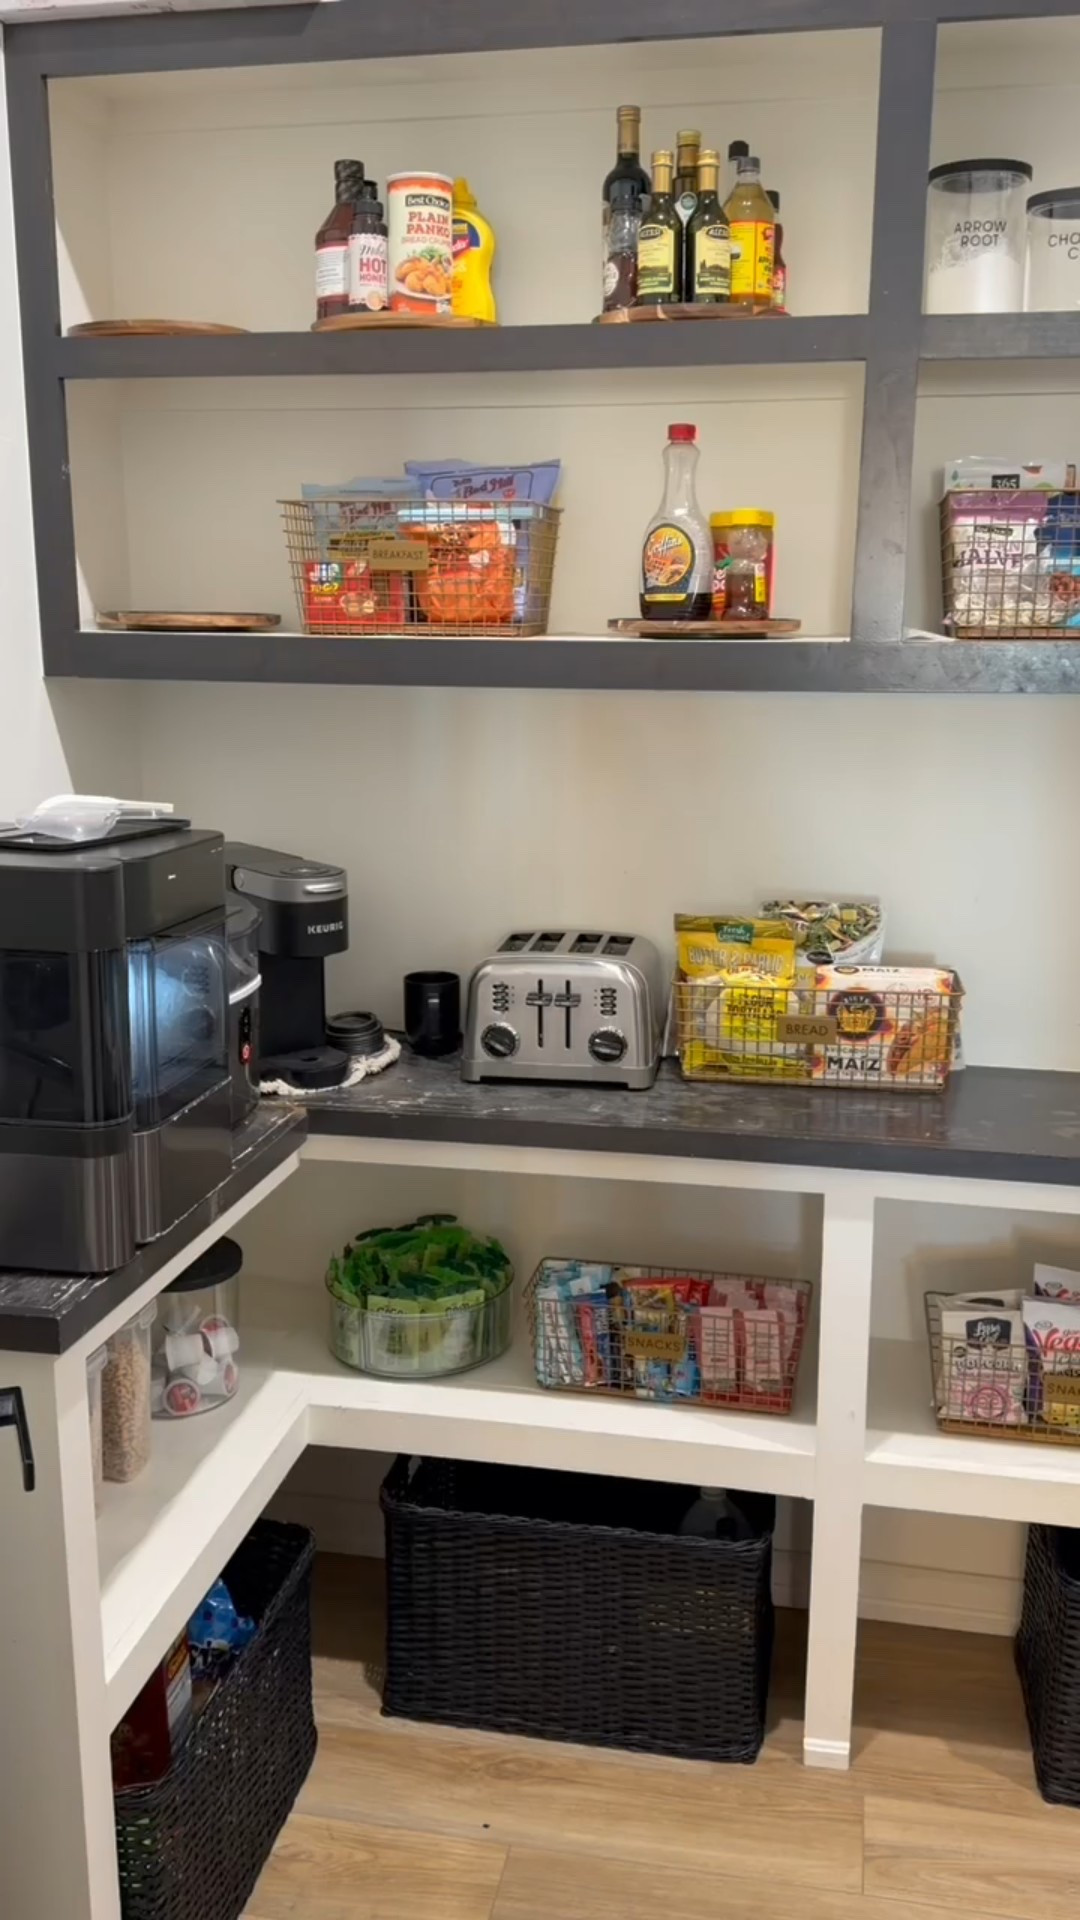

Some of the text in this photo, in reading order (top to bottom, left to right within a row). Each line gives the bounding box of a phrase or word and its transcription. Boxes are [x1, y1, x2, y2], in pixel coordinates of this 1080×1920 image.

[408, 211, 448, 225] PLAIN
[406, 224, 449, 238] PANKO
[954, 220, 1007, 233] ARROW
[961, 233, 1000, 247] ROOT
[359, 257, 387, 274] HOT
[995, 477, 1017, 489] 365
[372, 549, 424, 560] BREAKFAST
[307, 921, 344, 935] KEURIG
[723, 925, 746, 934] Fresh
[785, 1022, 828, 1037] BREAD
[627, 1334, 681, 1351] SNACKS
[1047, 1381, 1080, 1396] SNA
